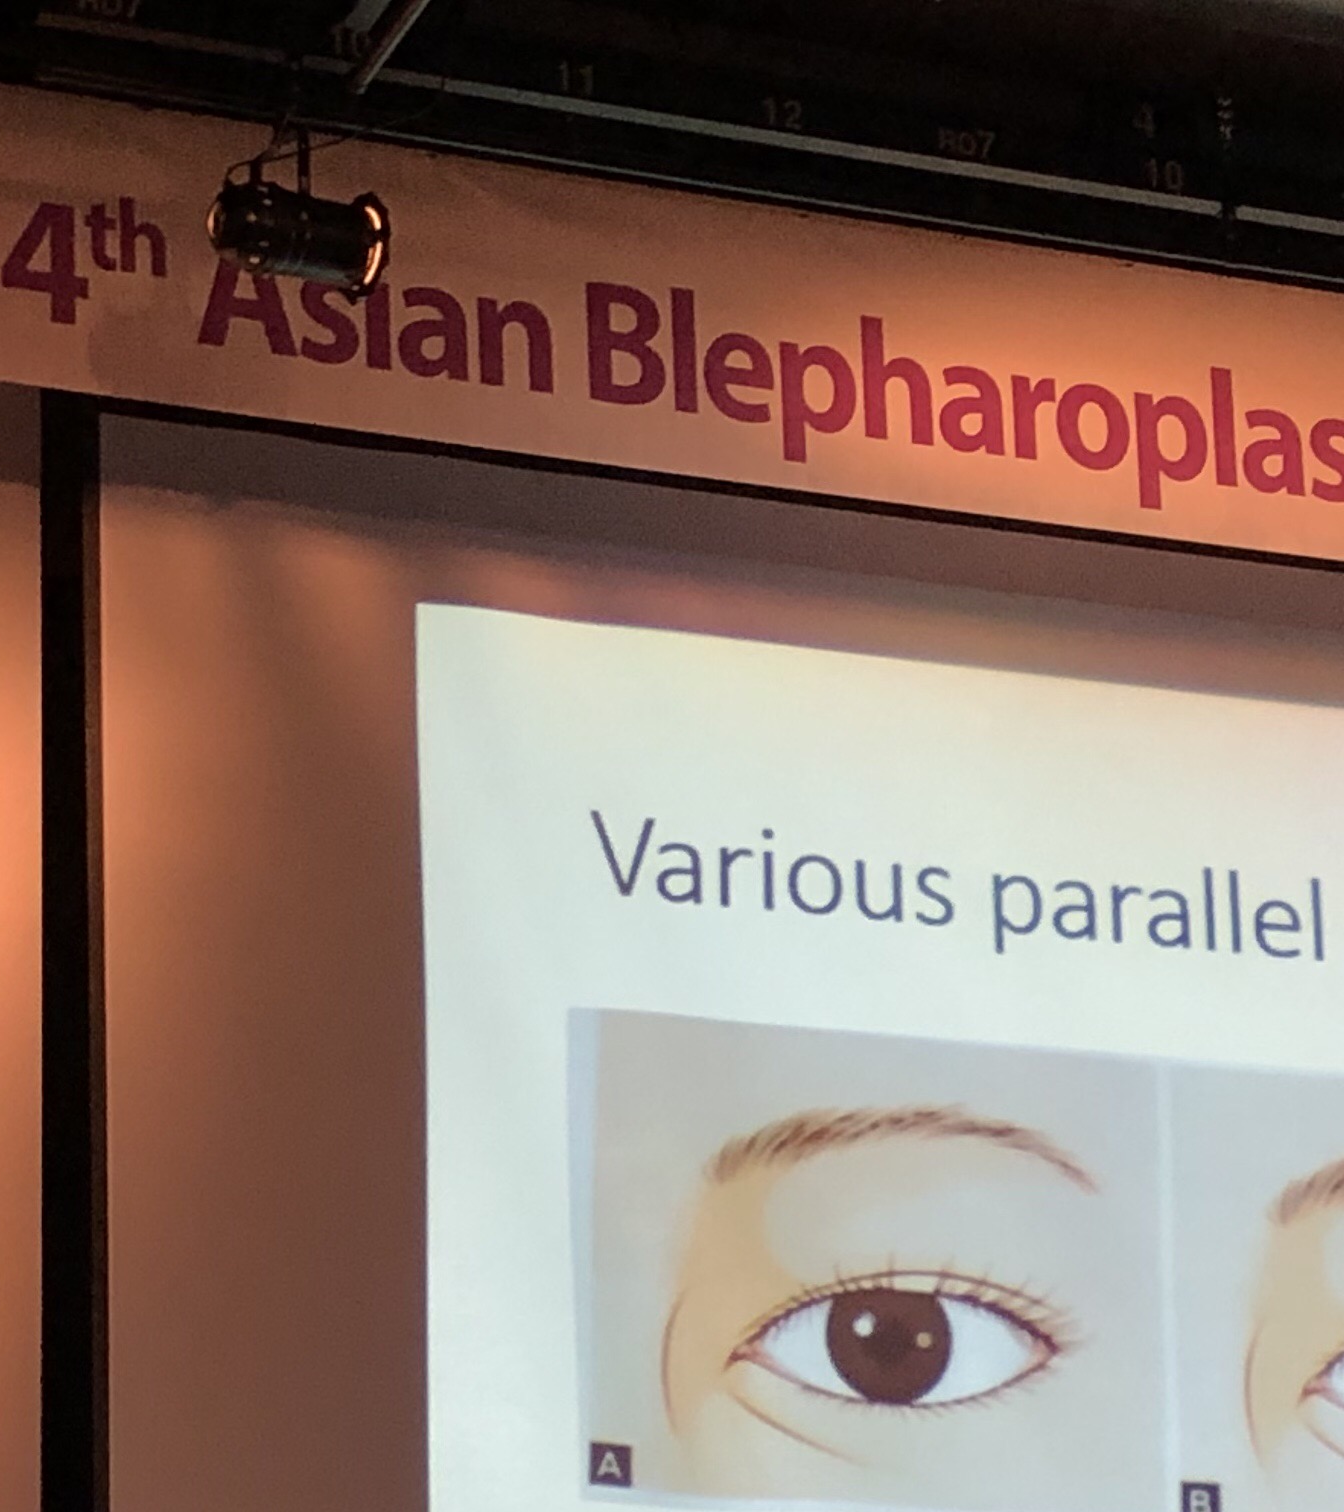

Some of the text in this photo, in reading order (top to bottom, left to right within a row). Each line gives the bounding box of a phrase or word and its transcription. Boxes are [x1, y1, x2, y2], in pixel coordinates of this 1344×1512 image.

[763, 97, 803, 131] 12
[2, 197, 167, 324] 4th
[198, 252, 554, 394] Asian
[591, 809, 955, 928] Various
[992, 866, 1326, 962] parallel
[596, 1450, 623, 1479] A
